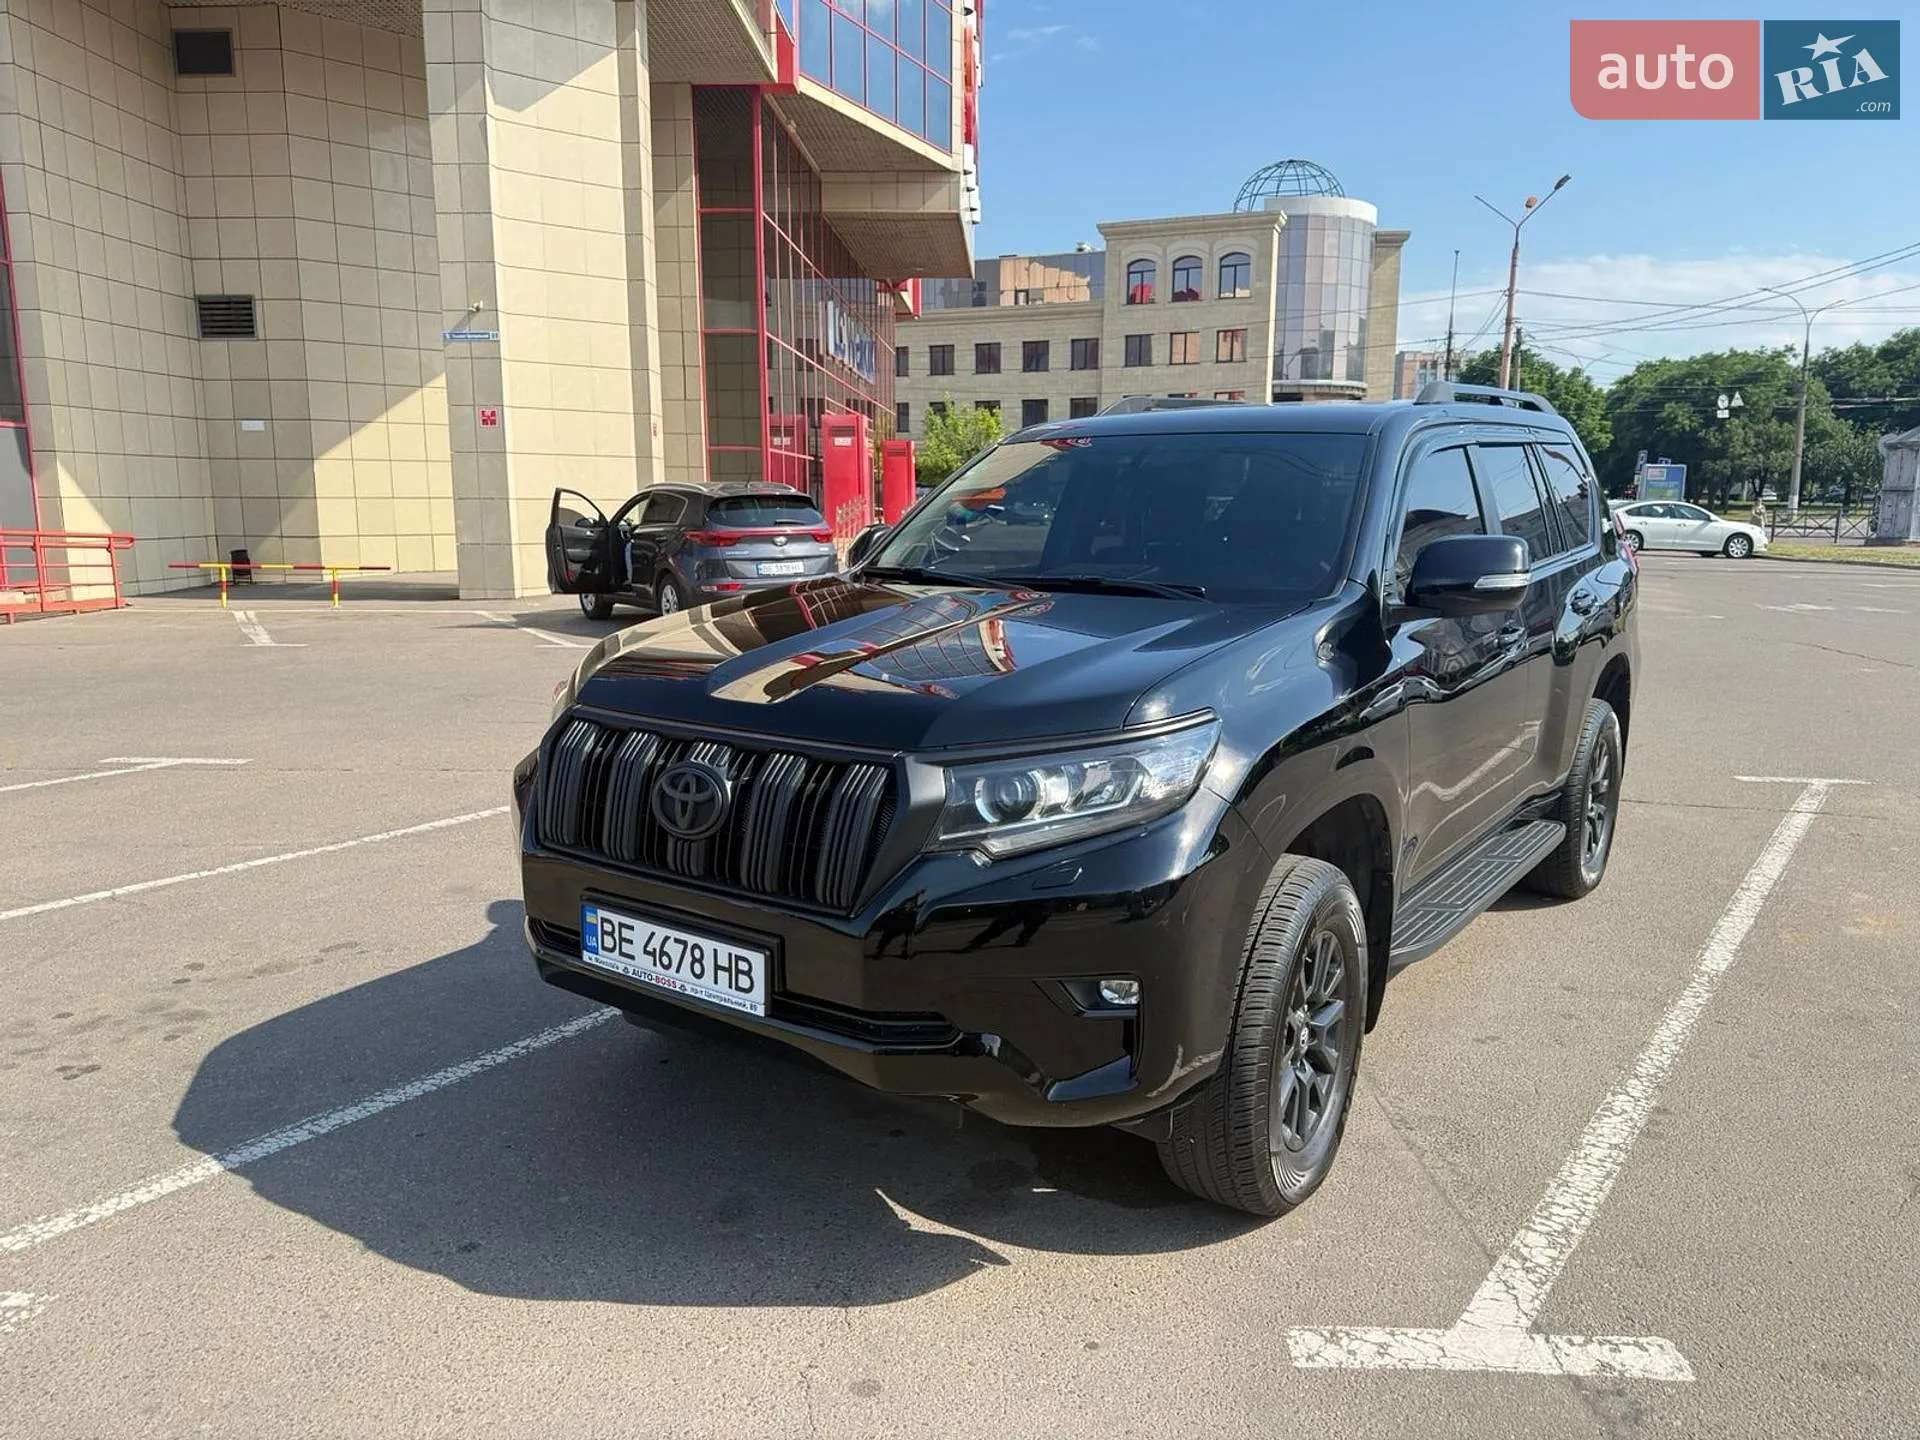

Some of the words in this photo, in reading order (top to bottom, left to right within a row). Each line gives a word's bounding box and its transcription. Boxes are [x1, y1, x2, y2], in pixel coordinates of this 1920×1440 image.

[586, 936, 597, 948] UA
[600, 917, 635, 960] BE
[643, 931, 705, 980] 4678
[714, 949, 755, 994] HB
[631, 969, 677, 989] AUTO-BOSS
